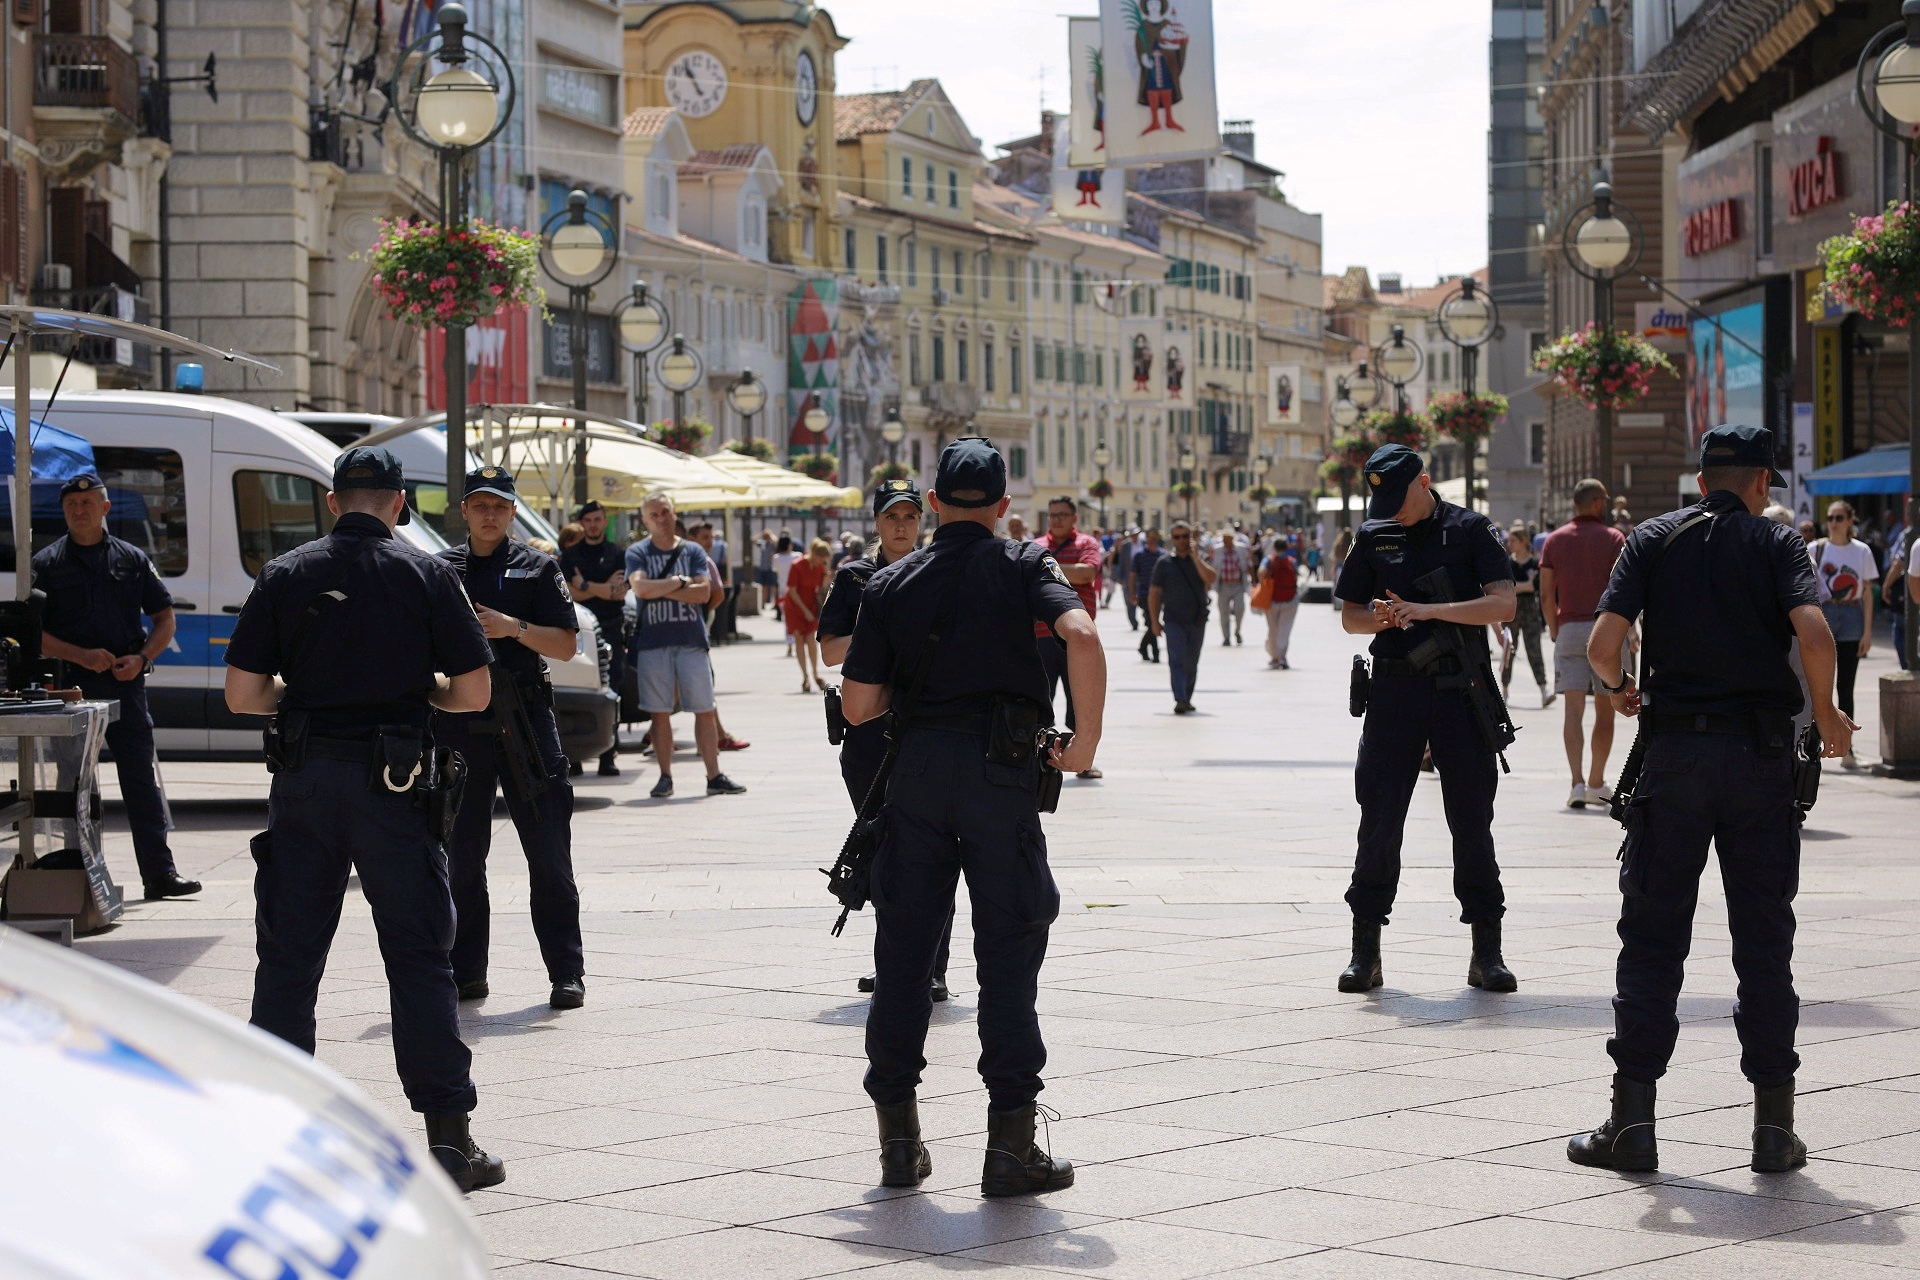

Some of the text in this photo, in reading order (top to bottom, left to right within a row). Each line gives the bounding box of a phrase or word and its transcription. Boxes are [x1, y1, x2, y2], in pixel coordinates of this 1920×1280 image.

[1651, 308, 1684, 328] dm
[1824, 424, 1834, 468] HOM
[647, 600, 698, 625] RULES
